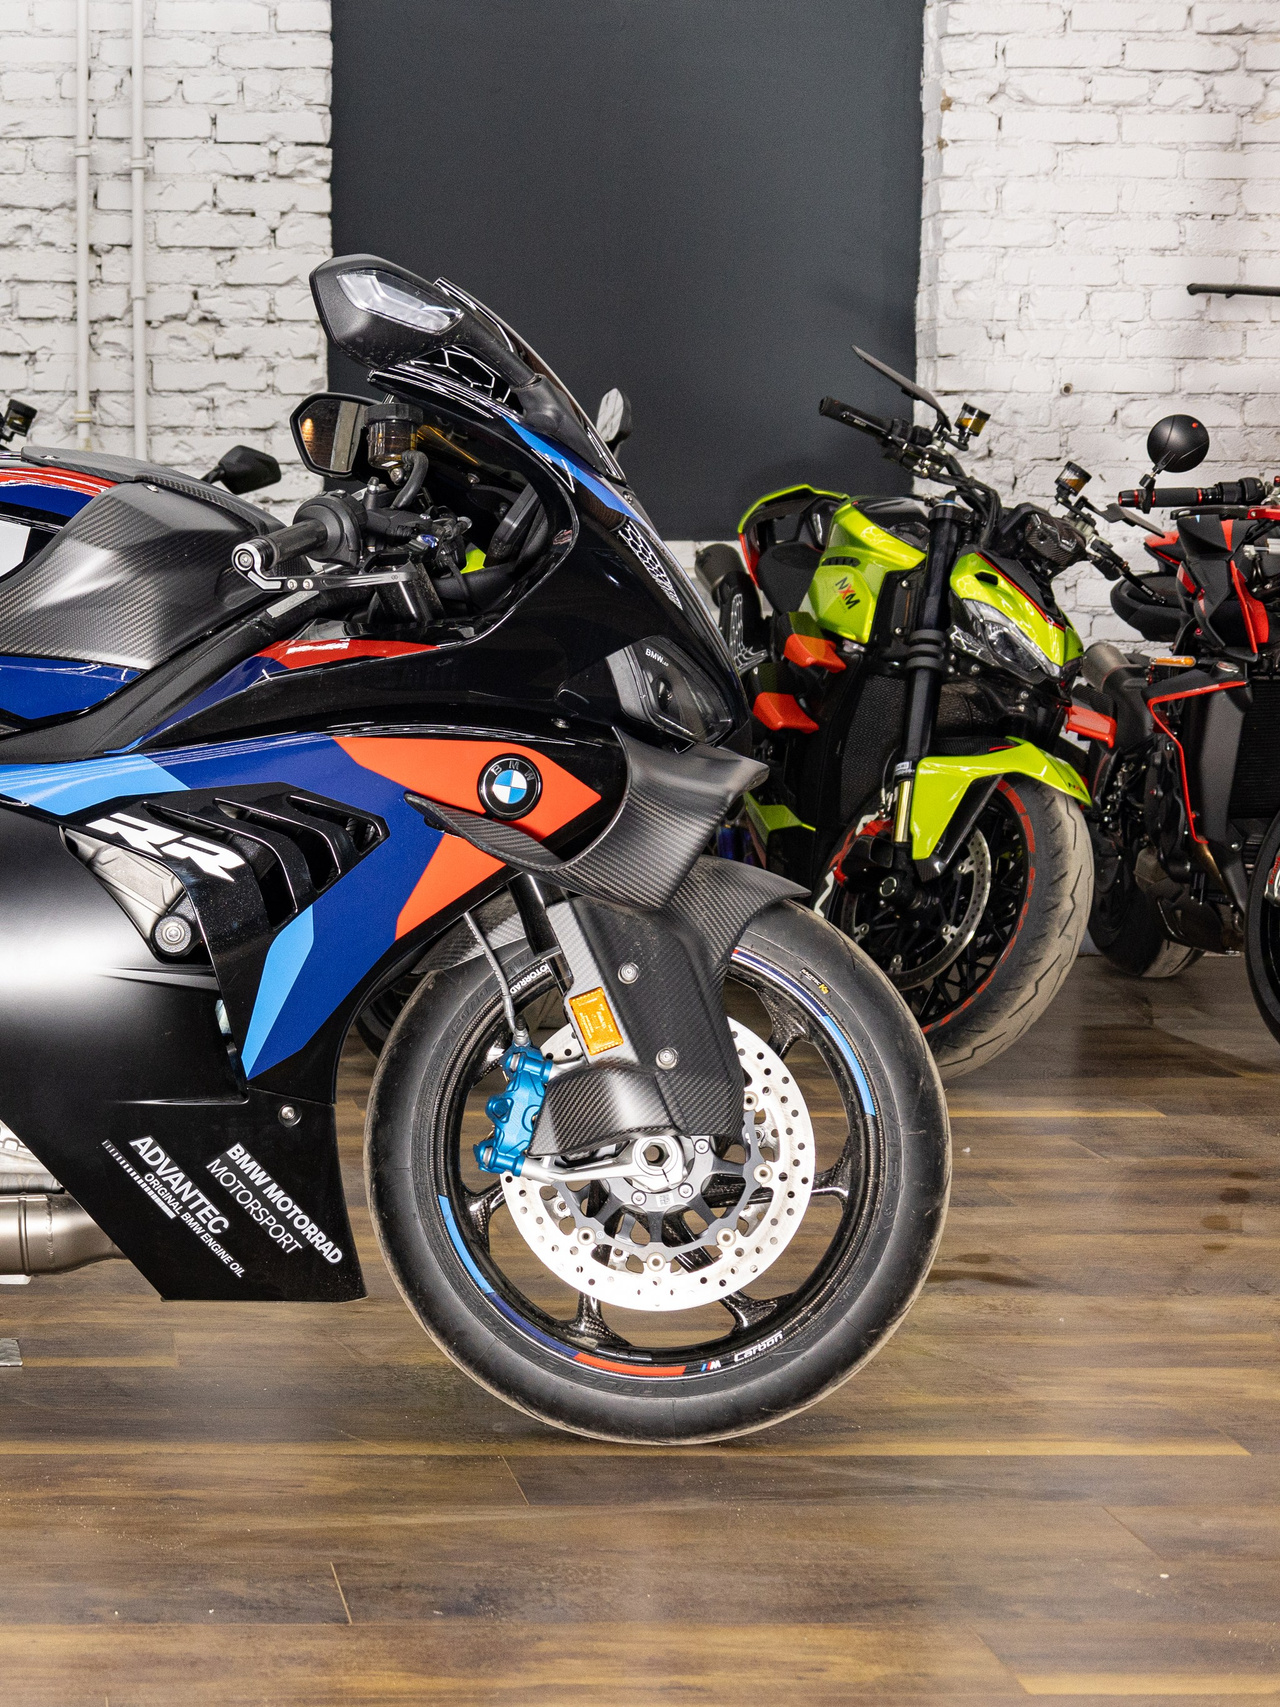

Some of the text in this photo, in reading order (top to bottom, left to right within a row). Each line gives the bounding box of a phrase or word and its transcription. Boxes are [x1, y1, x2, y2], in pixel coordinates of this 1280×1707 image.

[834, 576, 861, 610] NXM
[645, 647, 664, 663] BMW
[490, 759, 536, 782] BMW
[85, 802, 246, 882] RR
[129, 1136, 231, 1235] ADVANTEC
[144, 1172, 247, 1279] ORIGINAL BMW ENGINE OIL
[205, 1158, 304, 1255] MOTORSPORT
[225, 1143, 344, 1265] BMW MOTORRAD
